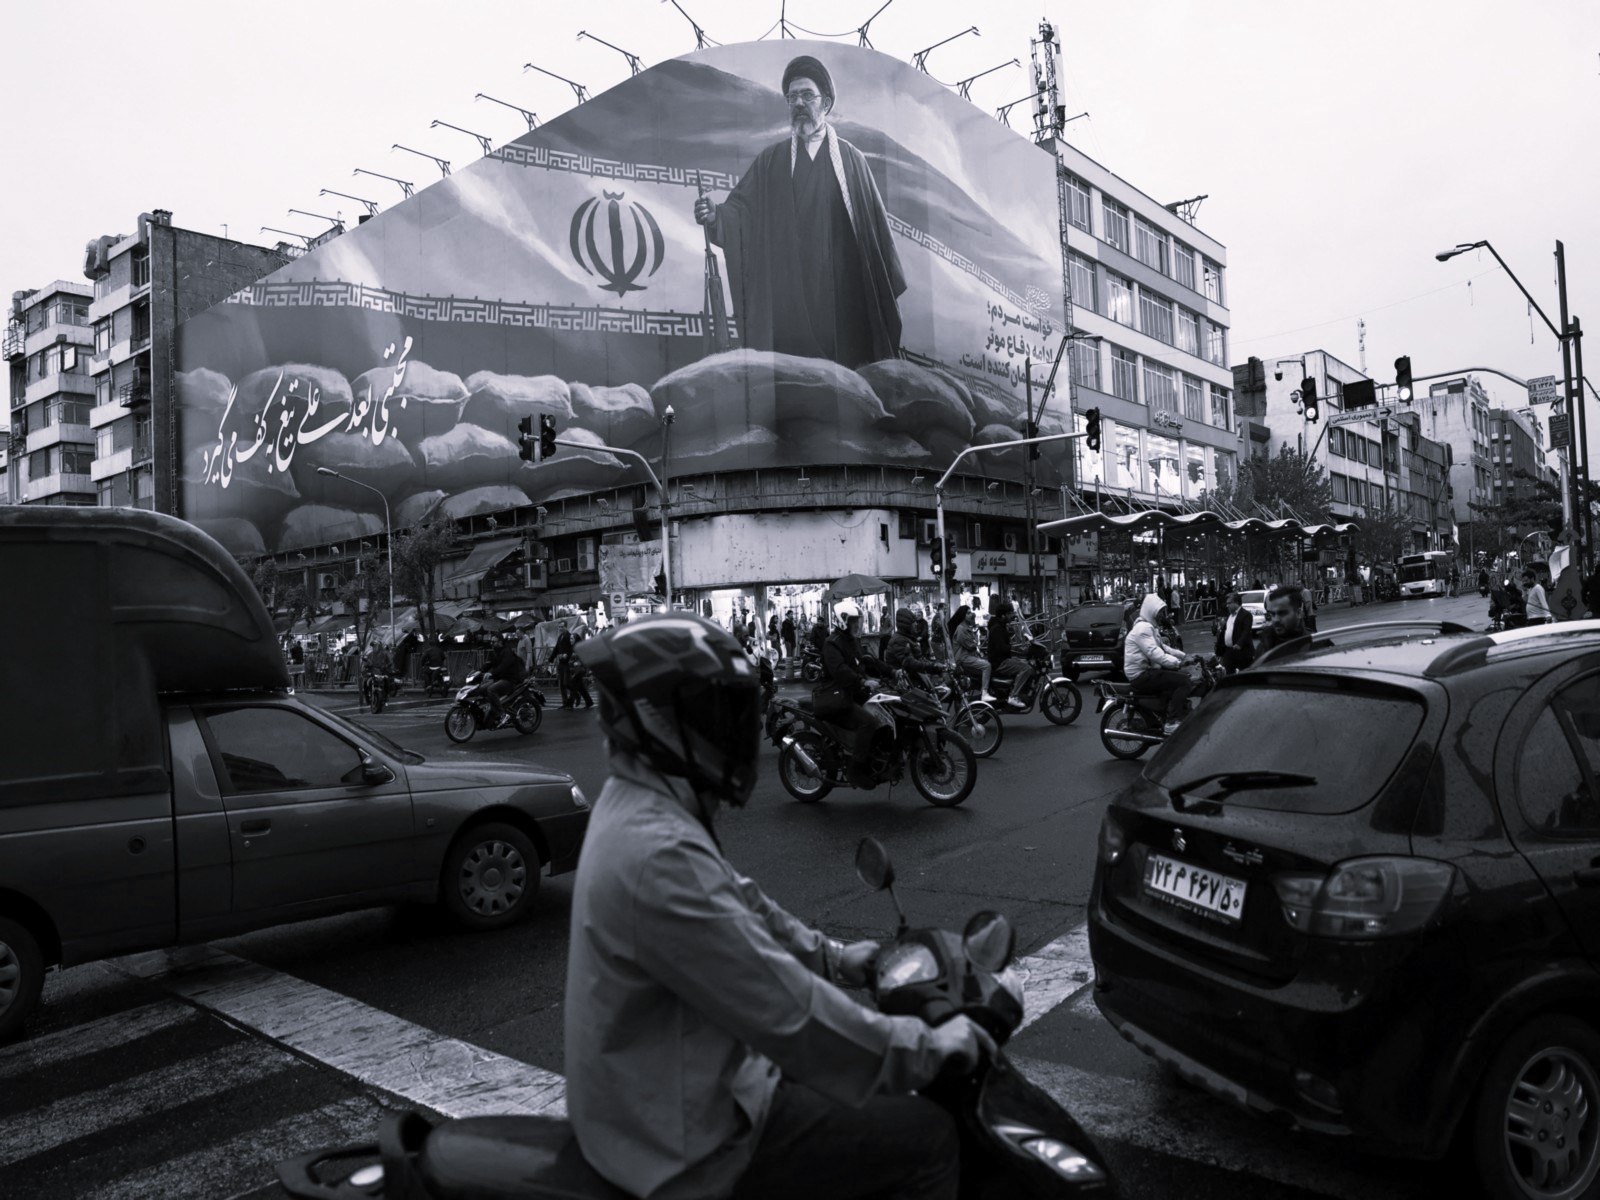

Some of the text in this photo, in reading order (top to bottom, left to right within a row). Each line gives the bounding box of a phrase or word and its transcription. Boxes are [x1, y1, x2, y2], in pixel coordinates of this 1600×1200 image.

[1022, 316, 1053, 341] خواست
[1007, 334, 1030, 358] دفاع
[1032, 344, 1053, 363] ادامه
[988, 361, 1010, 379] کننده
[372, 336, 413, 446] مجتبی
[235, 369, 284, 463] کف
[276, 378, 299, 473] تیغ
[1332, 412, 1372, 424] جمهوری اسلامی
[977, 553, 1007, 571] کوه نور
